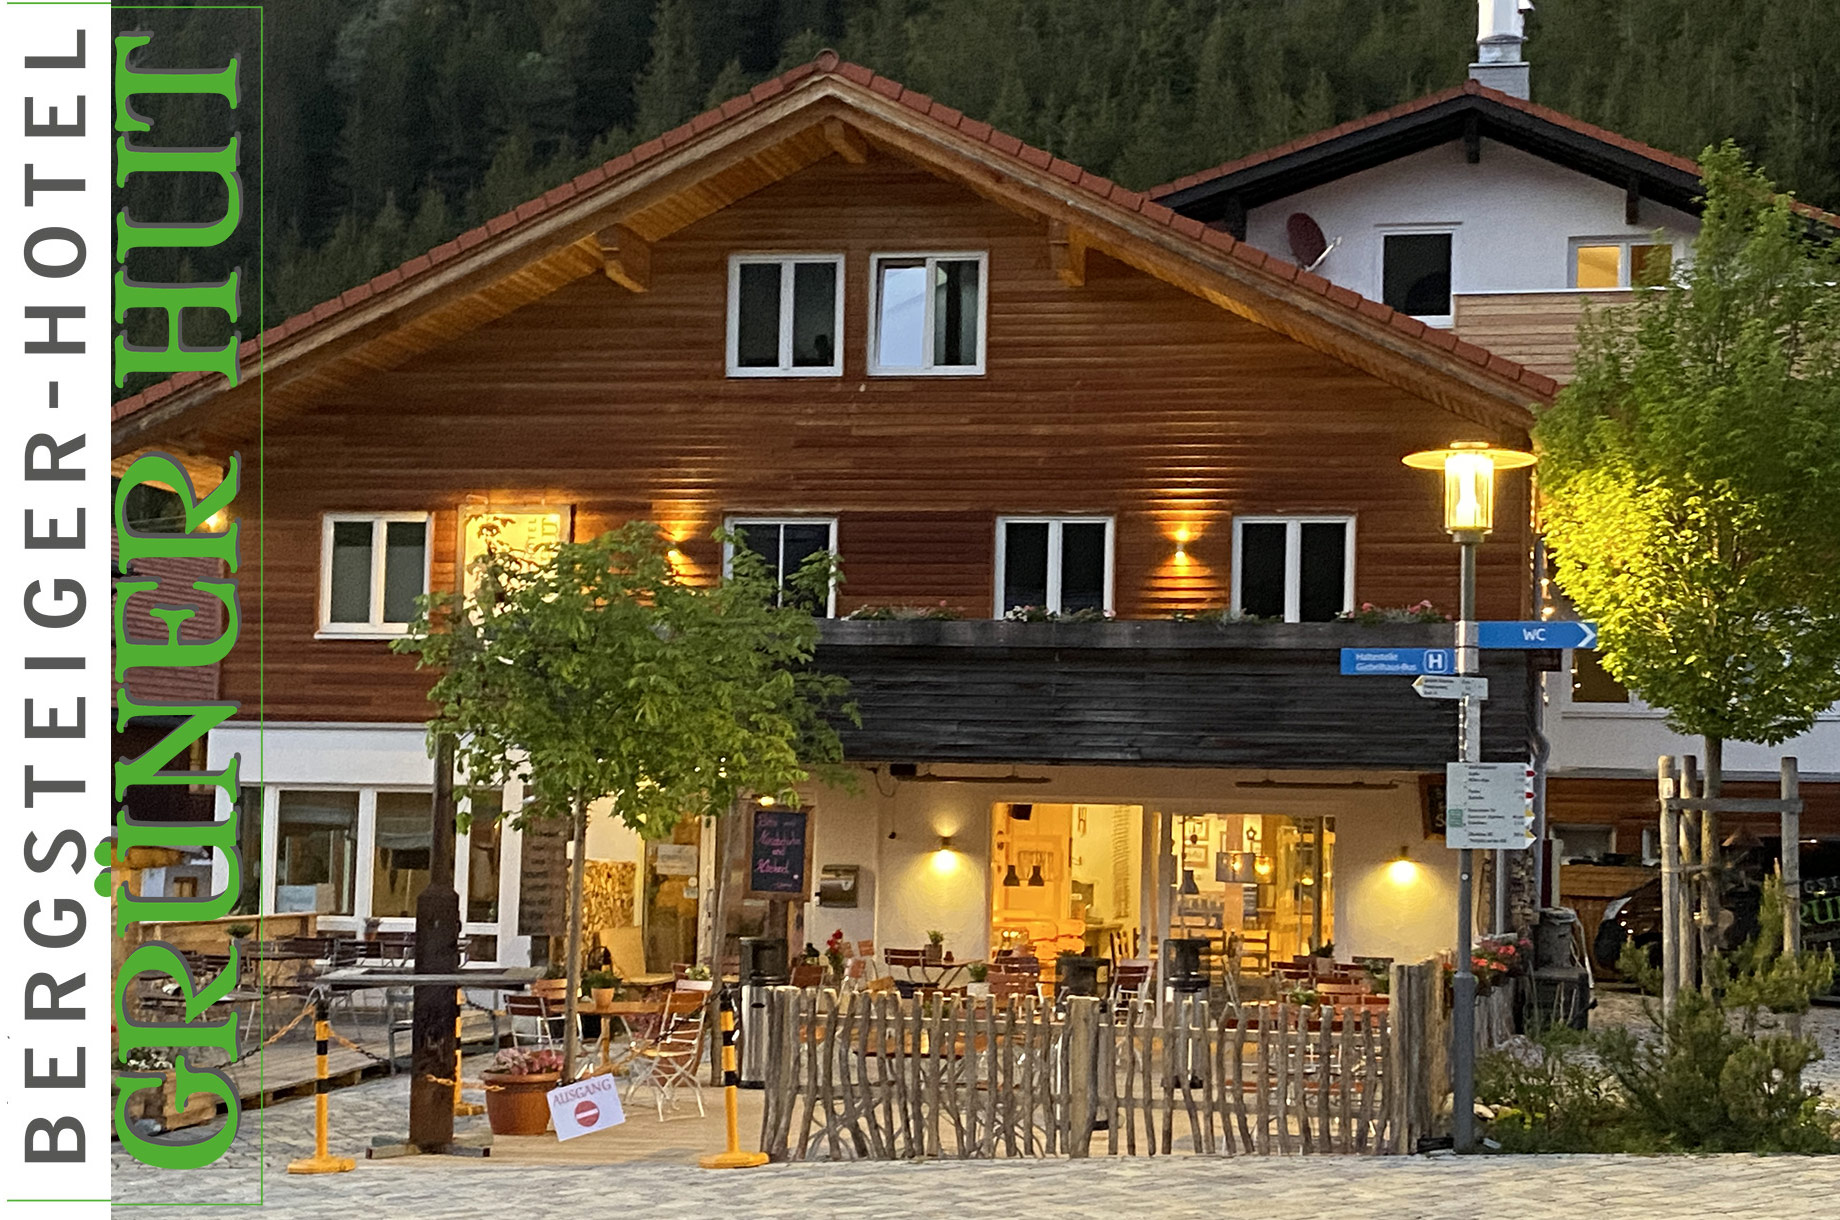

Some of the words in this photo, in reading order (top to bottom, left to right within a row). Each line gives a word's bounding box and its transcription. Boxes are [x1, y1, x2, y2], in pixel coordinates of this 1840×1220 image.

[1522, 627, 1546, 642] WC
[1428, 653, 1443, 670] H
[552, 1078, 612, 1107] AUSGANG
